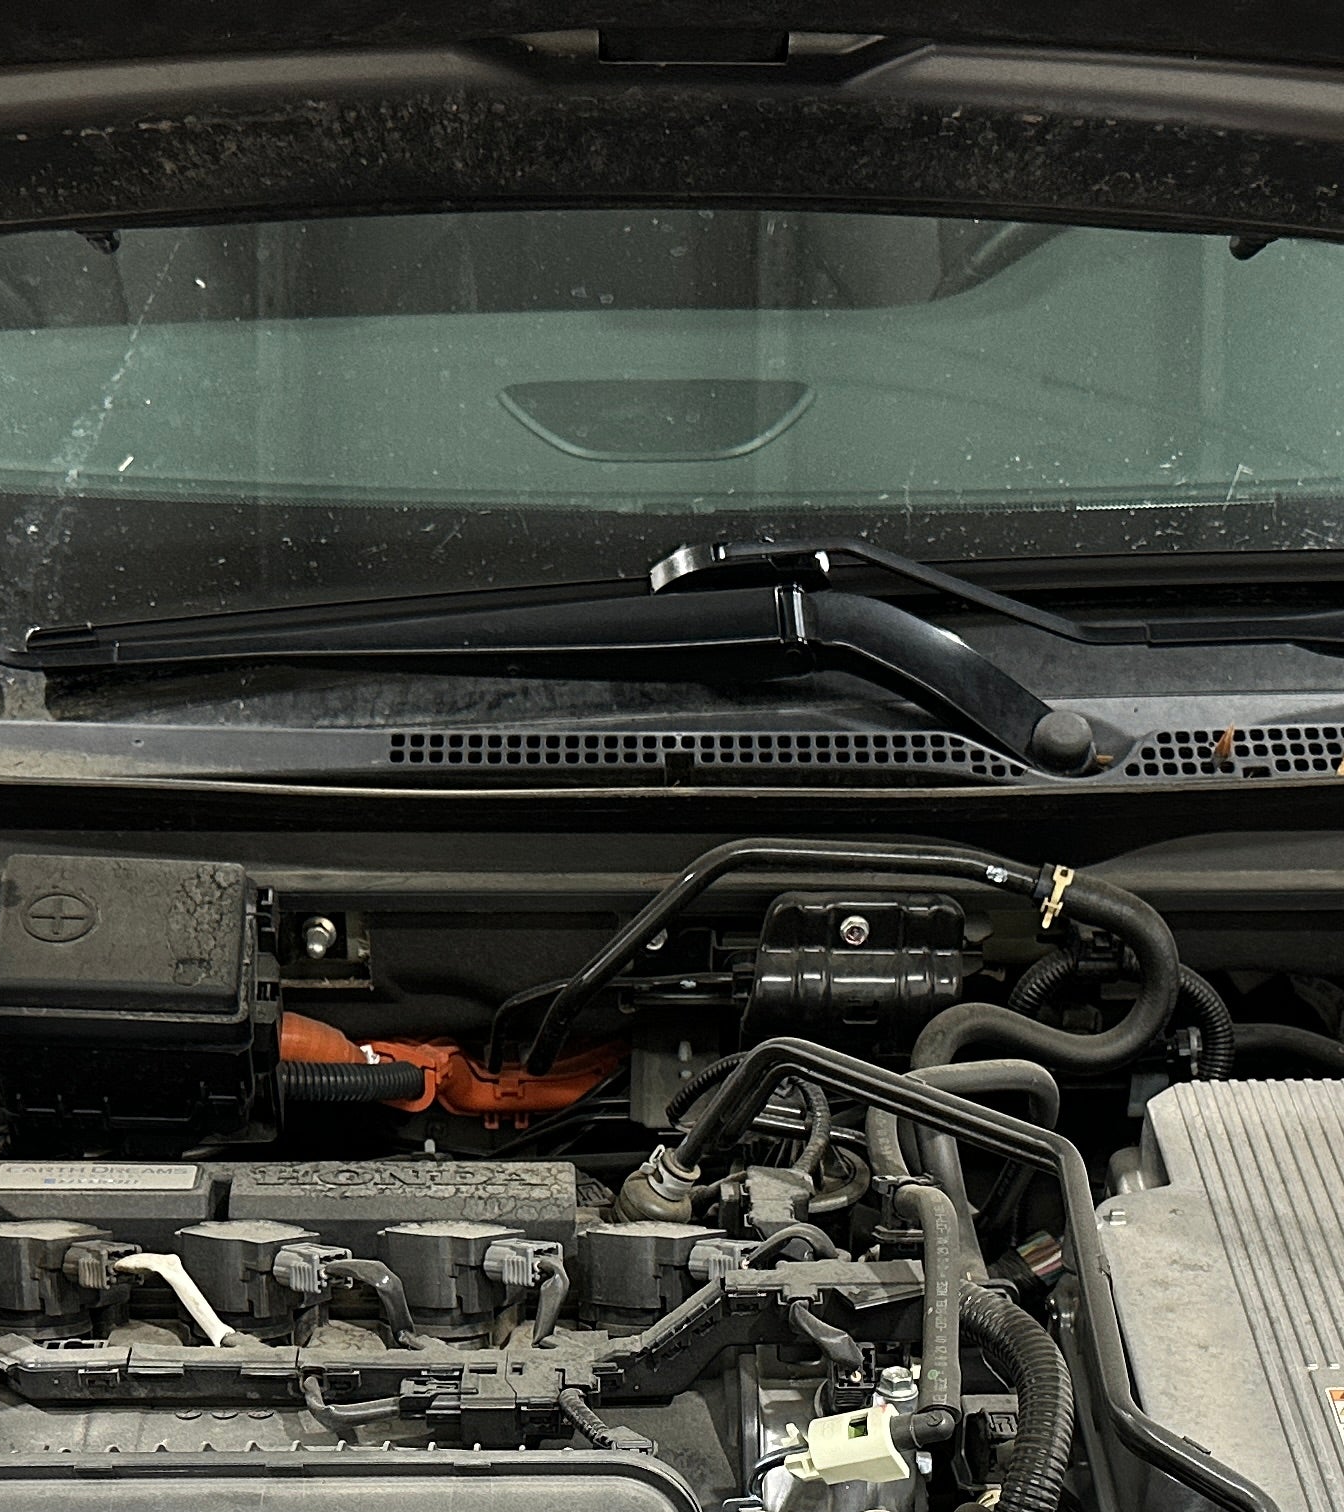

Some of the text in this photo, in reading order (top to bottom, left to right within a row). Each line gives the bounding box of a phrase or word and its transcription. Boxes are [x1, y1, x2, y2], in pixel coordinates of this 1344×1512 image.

[6, 1166, 188, 1175] EARTH DREAMS
[255, 1168, 549, 1186] HONDA
